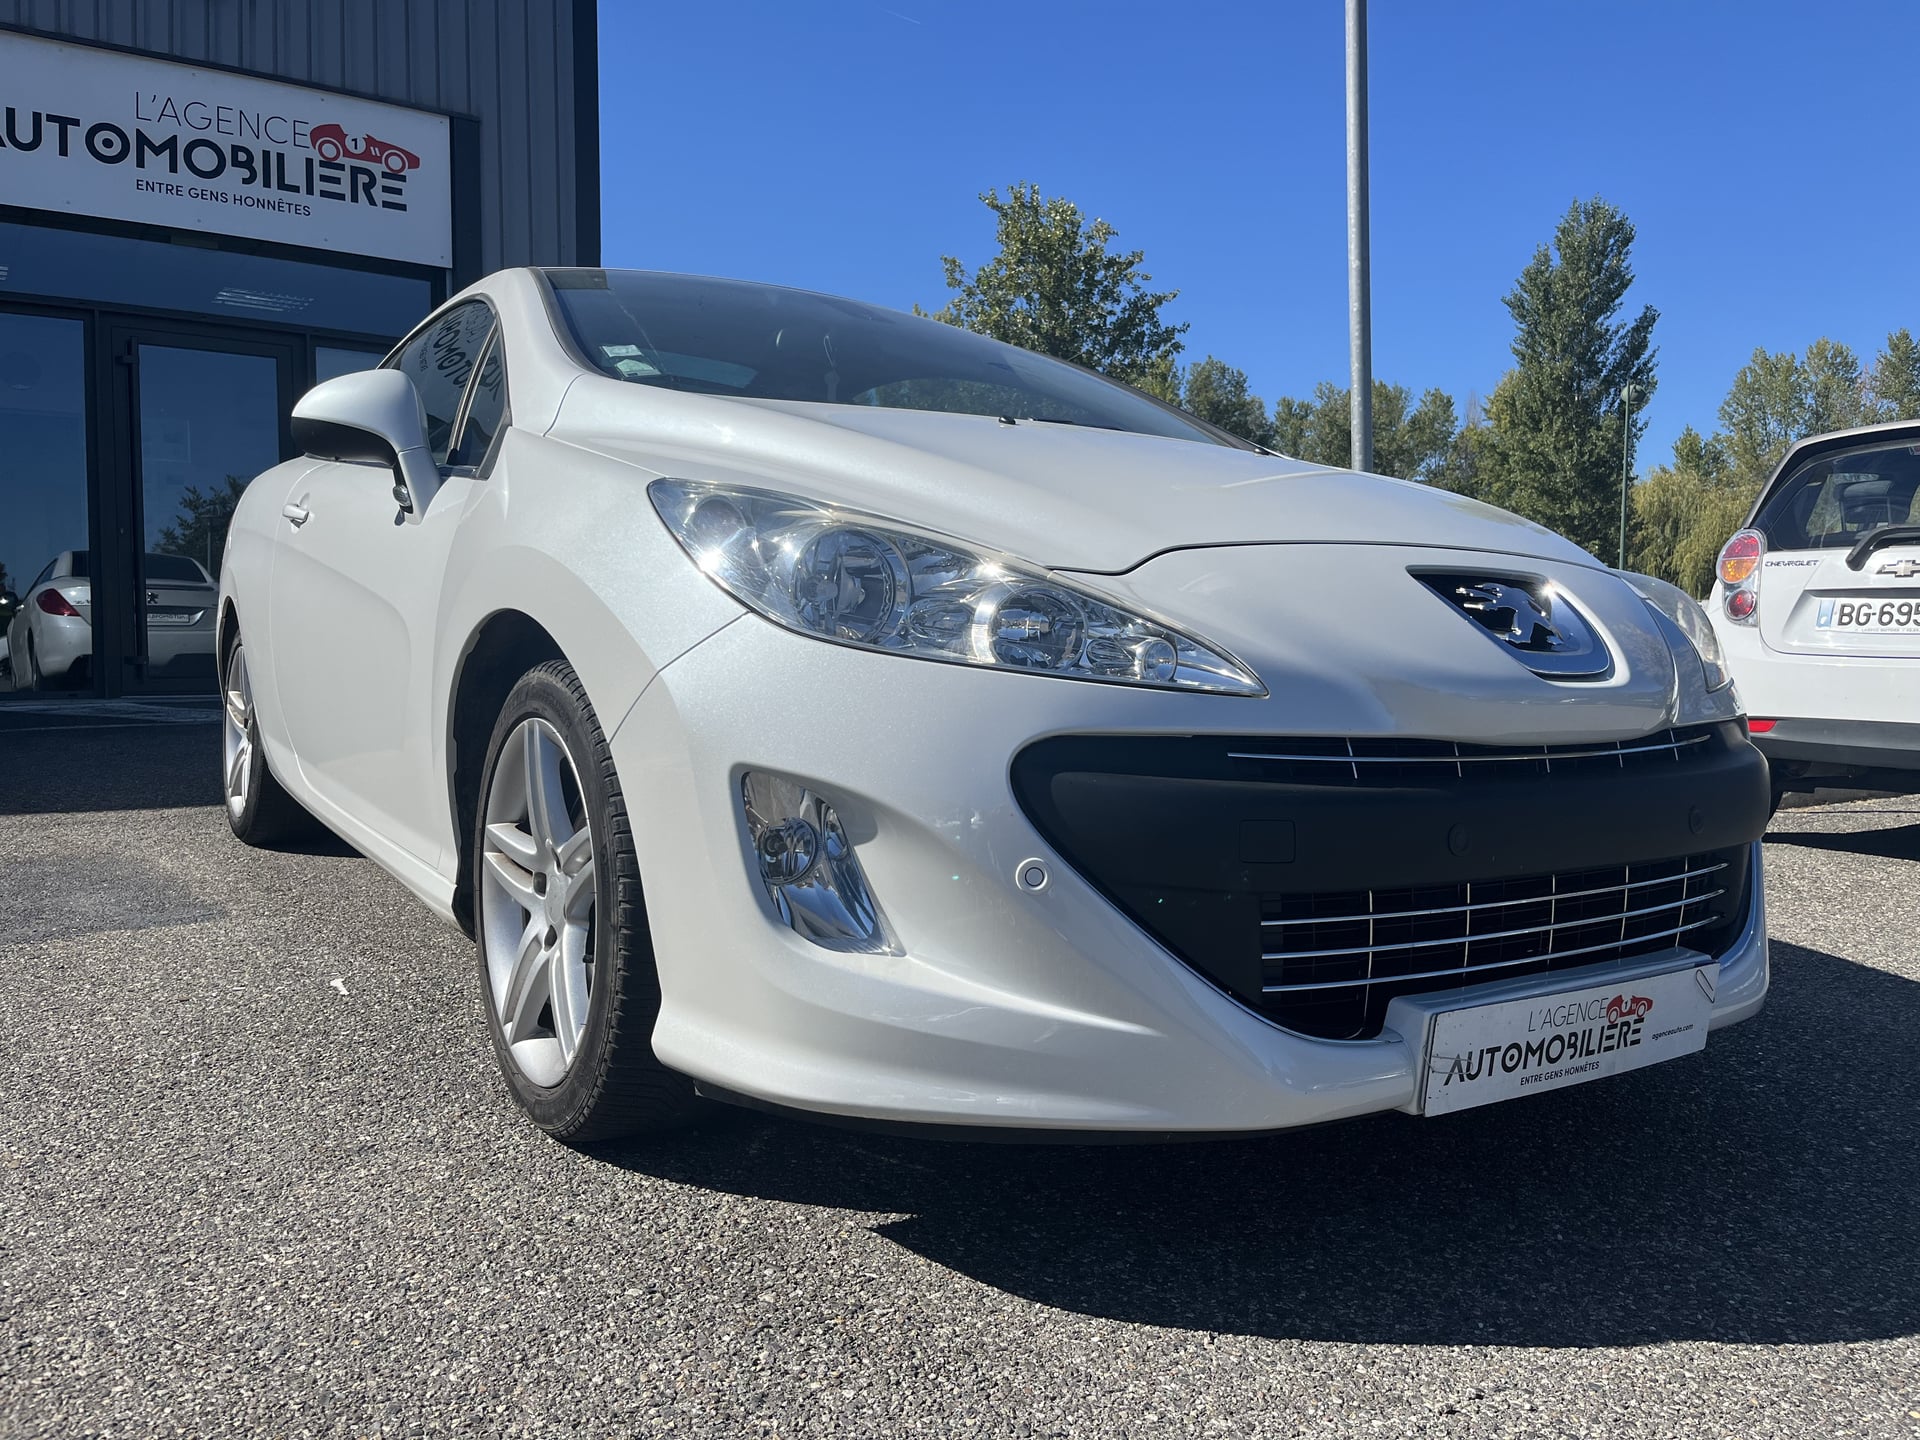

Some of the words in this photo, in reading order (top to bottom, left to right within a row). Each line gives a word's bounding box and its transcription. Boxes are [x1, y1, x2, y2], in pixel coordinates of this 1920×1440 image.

[135, 91, 310, 149] L'AGENCE
[0, 106, 407, 212] UTOMOBILIERE
[351, 138, 358, 150] 1
[136, 178, 184, 197] ENTRE
[188, 187, 229, 204] GENS
[233, 193, 311, 217] HONNÊTES
[1764, 559, 1819, 567] CHEVROLET
[1528, 997, 1608, 1032] L'AGENCE
[1652, 1023, 1693, 1040] agenceauto.com
[1443, 1017, 1645, 1086] AUTOMOBILIERE
[1520, 1072, 1543, 1086] ENTRE
[1544, 1069, 1563, 1081] GENS
[1564, 1060, 1600, 1077] HONNÊTES
